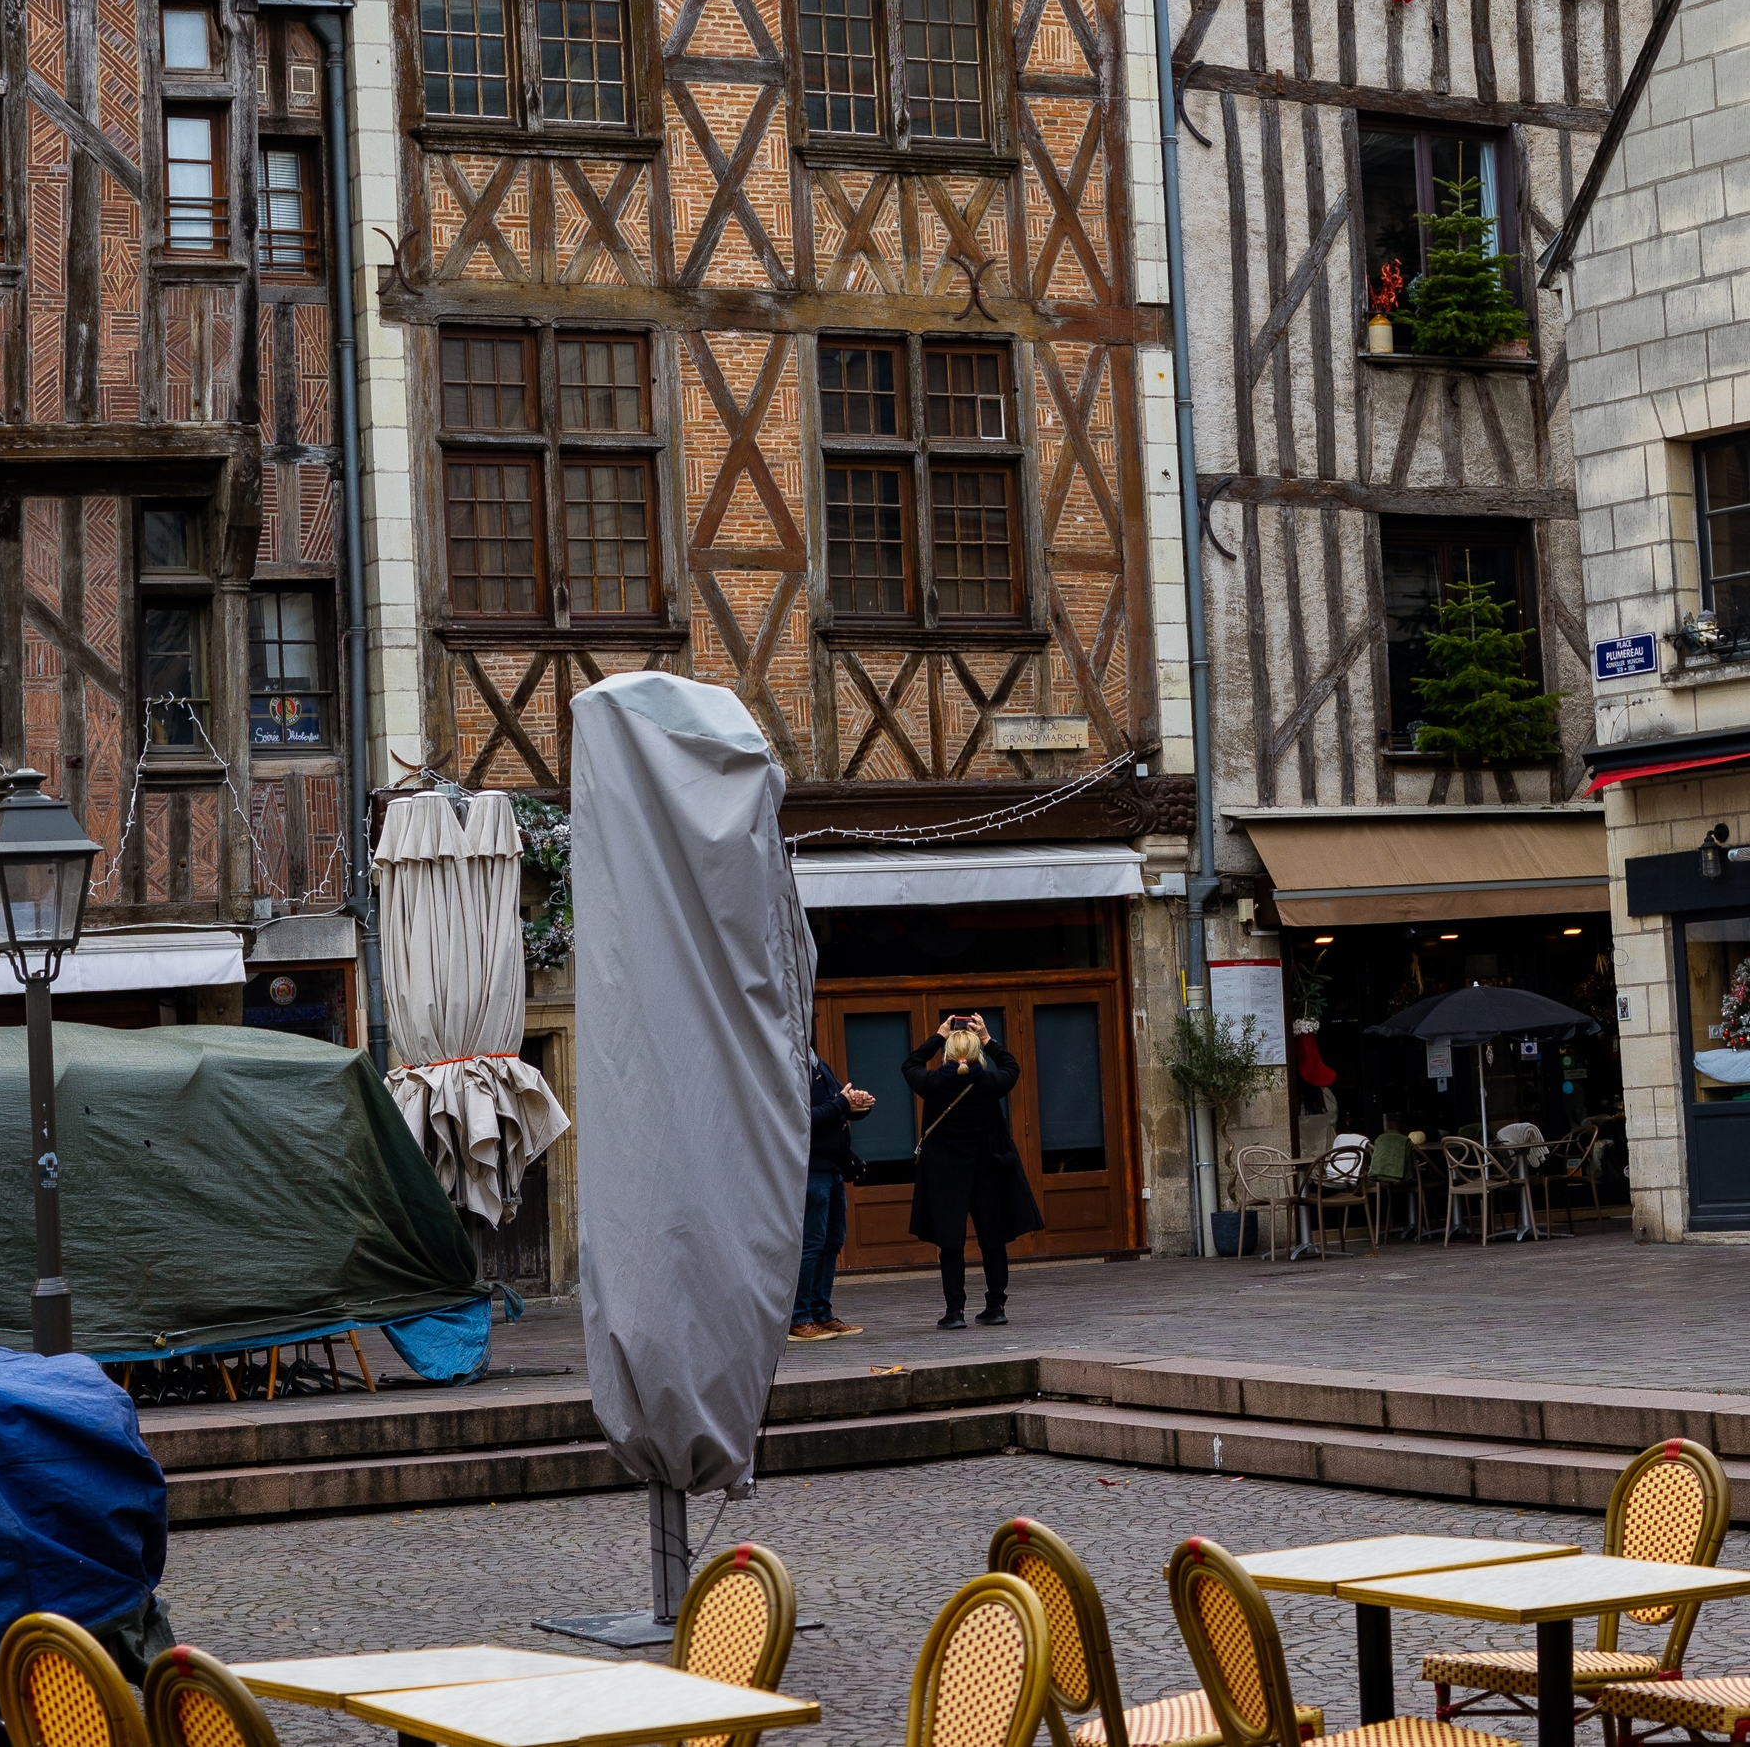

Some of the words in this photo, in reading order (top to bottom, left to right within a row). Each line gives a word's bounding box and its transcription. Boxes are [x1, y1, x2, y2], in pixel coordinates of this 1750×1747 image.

[1616, 639, 1632, 649] PLACE
[1605, 646, 1644, 662] PLUMEREAU
[1026, 722, 1045, 731] RUE
[1047, 722, 1060, 731] DU
[1002, 734, 1039, 744] GRAND
[1042, 733, 1084, 743] MARCHE
